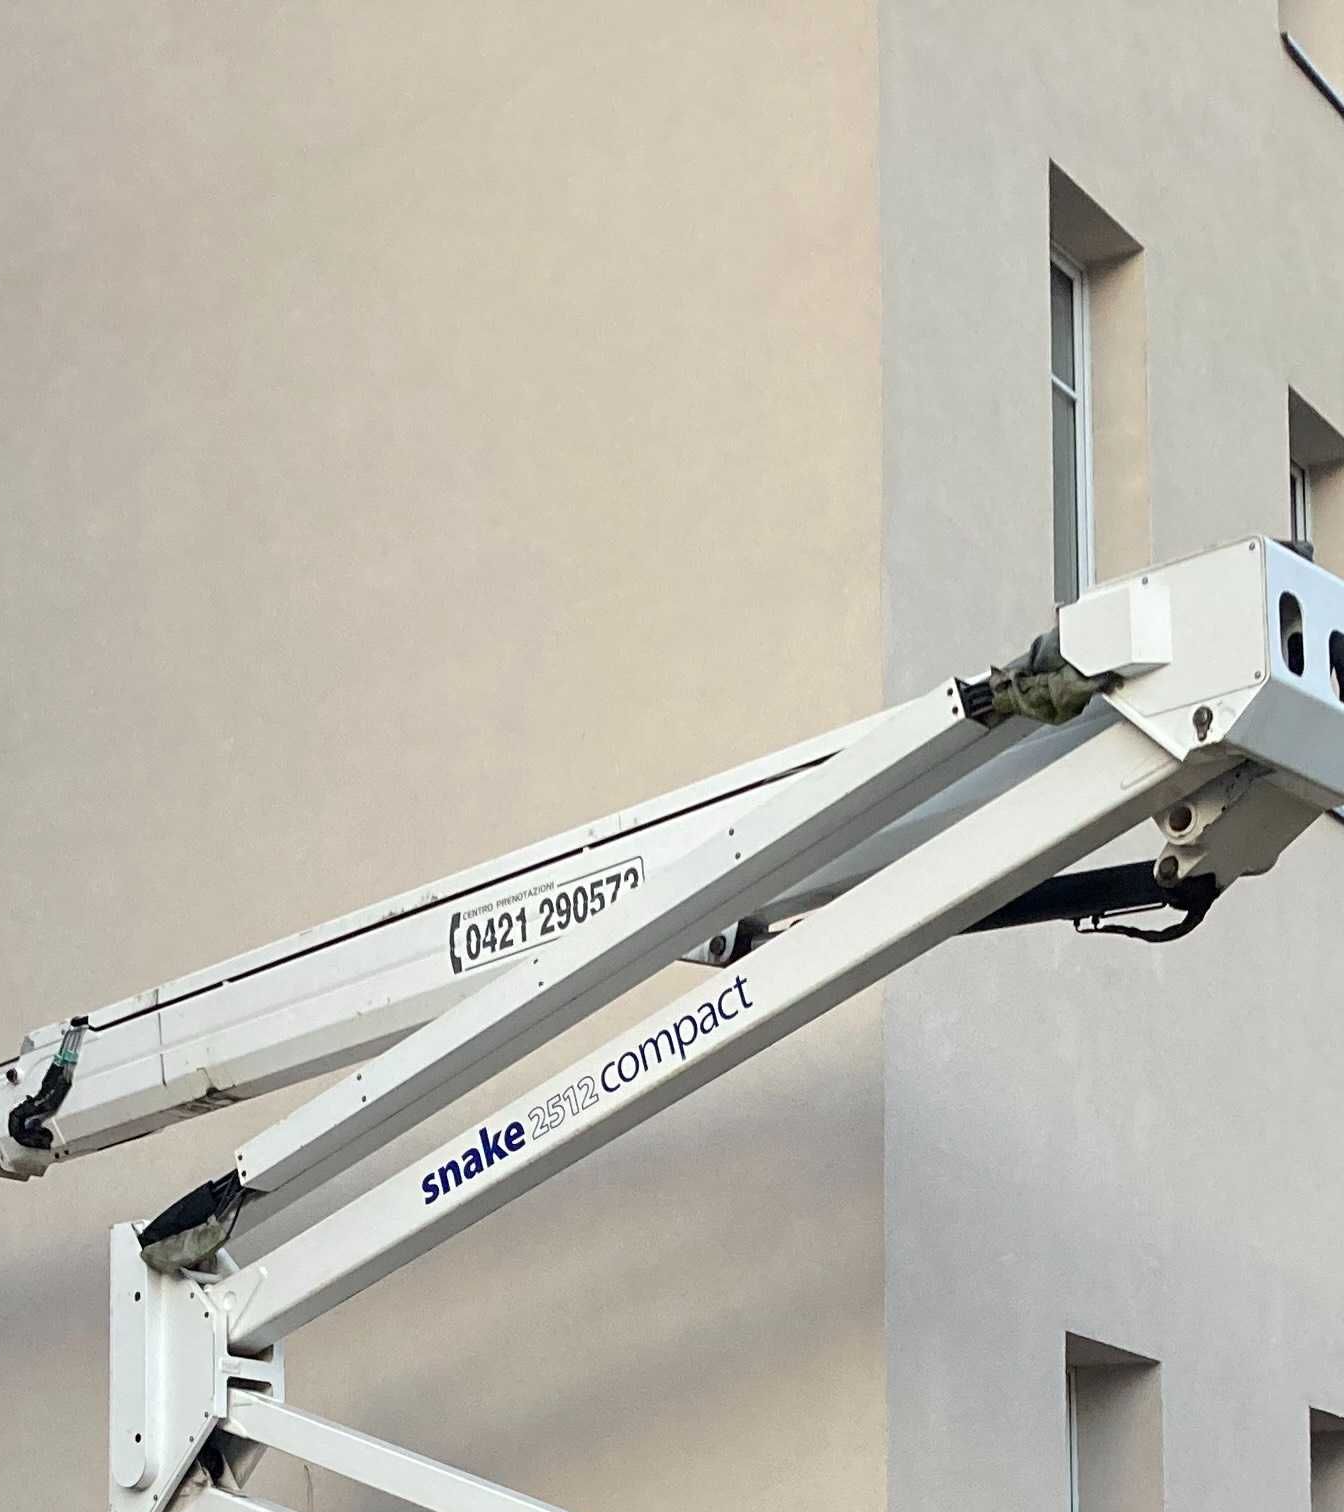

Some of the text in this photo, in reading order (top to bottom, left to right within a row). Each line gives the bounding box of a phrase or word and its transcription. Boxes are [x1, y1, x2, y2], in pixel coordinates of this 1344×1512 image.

[463, 881, 555, 921] CENTRO PRENOTAZIONI
[465, 907, 527, 961] 0421
[420, 974, 754, 1206] snake 2512 compact
